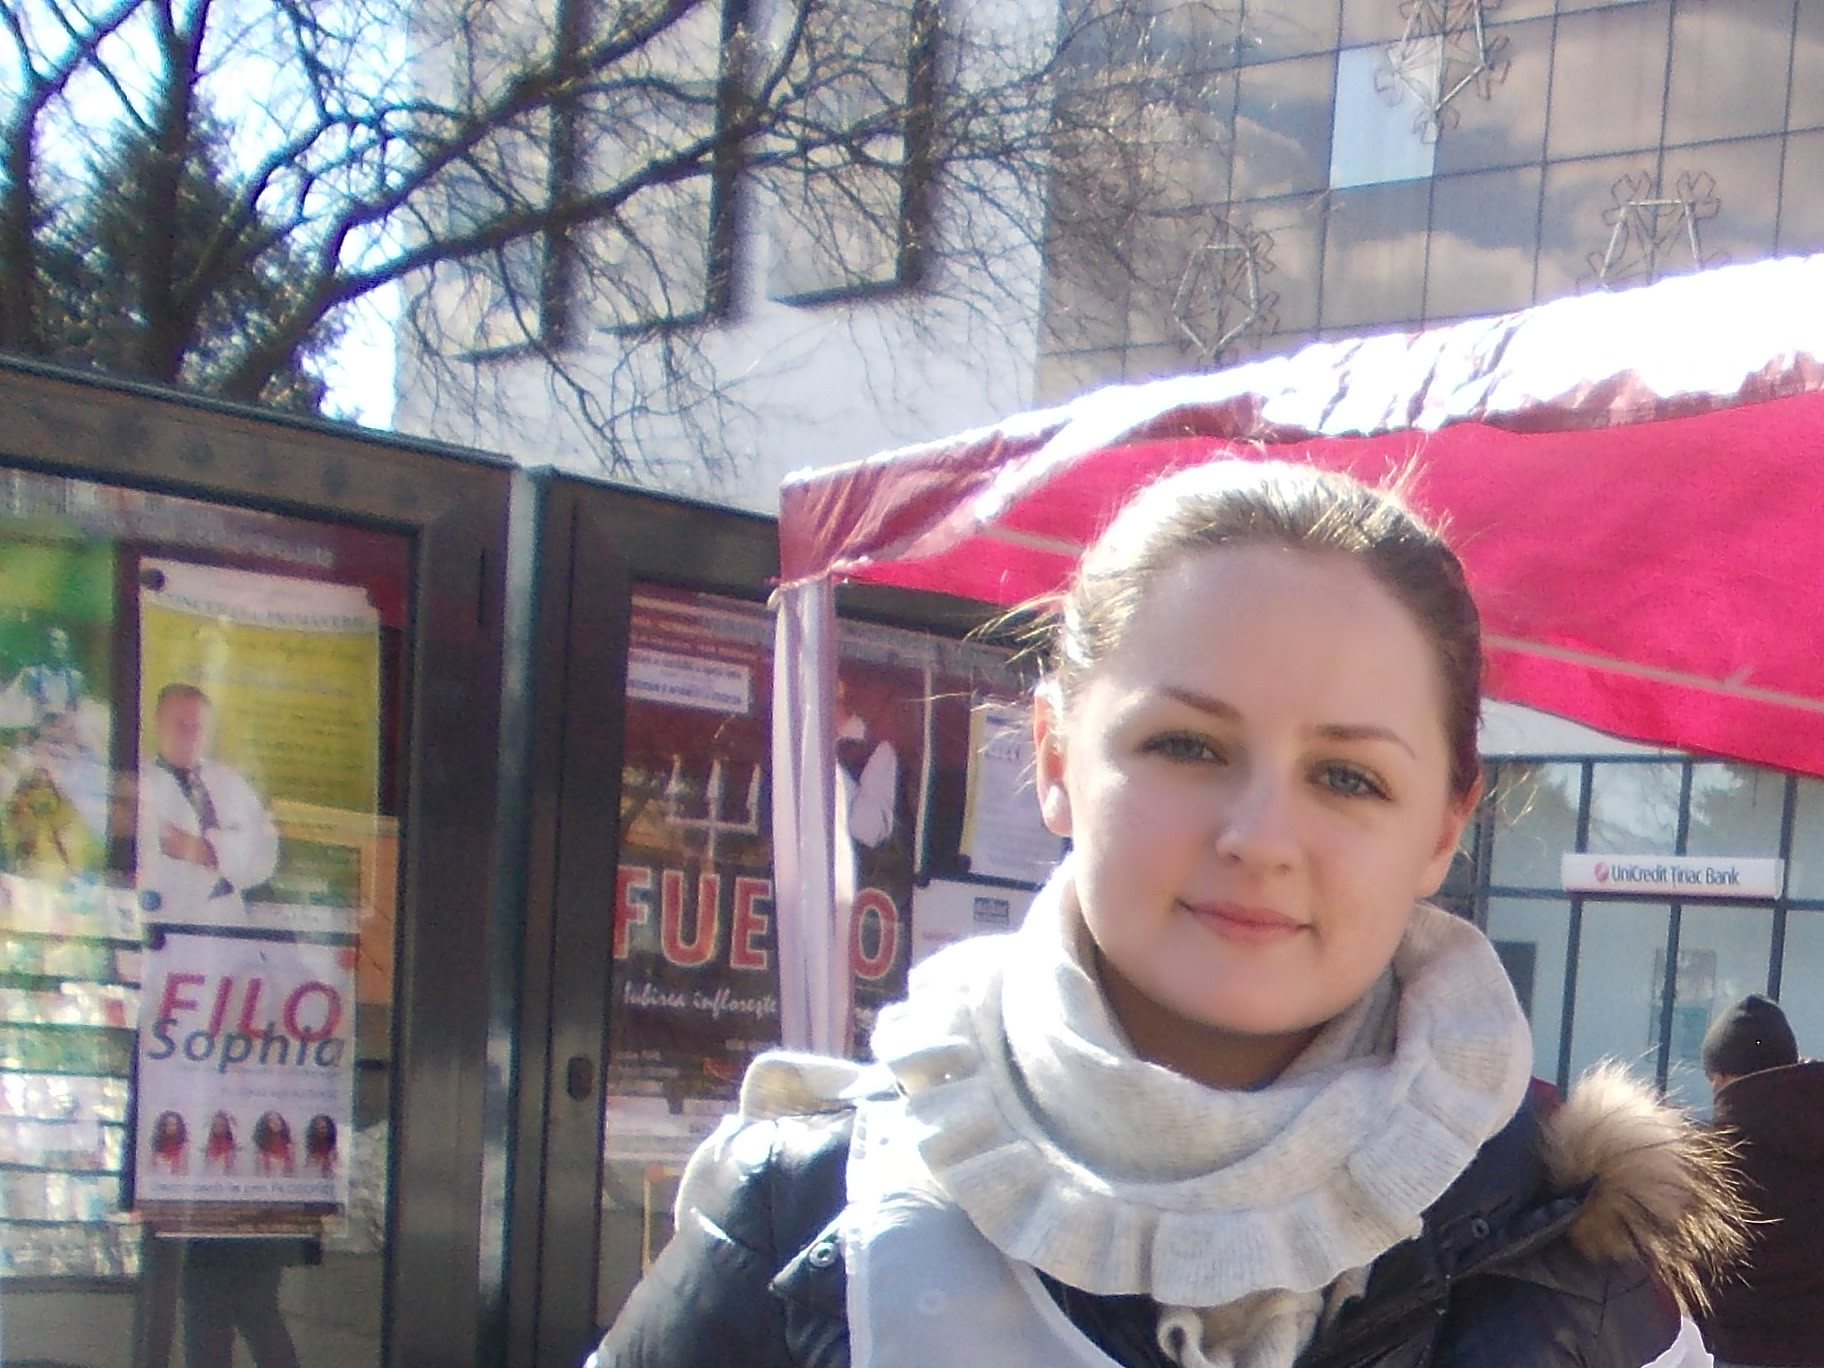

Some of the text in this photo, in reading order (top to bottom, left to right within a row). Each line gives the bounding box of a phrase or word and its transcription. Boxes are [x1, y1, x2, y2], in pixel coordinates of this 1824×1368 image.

[1611, 863, 1668, 883] UniCredit
[1705, 866, 1739, 886] Bank
[613, 865, 899, 981] FUEO
[159, 972, 342, 1043] FILO
[146, 1017, 345, 1075] Sophia
